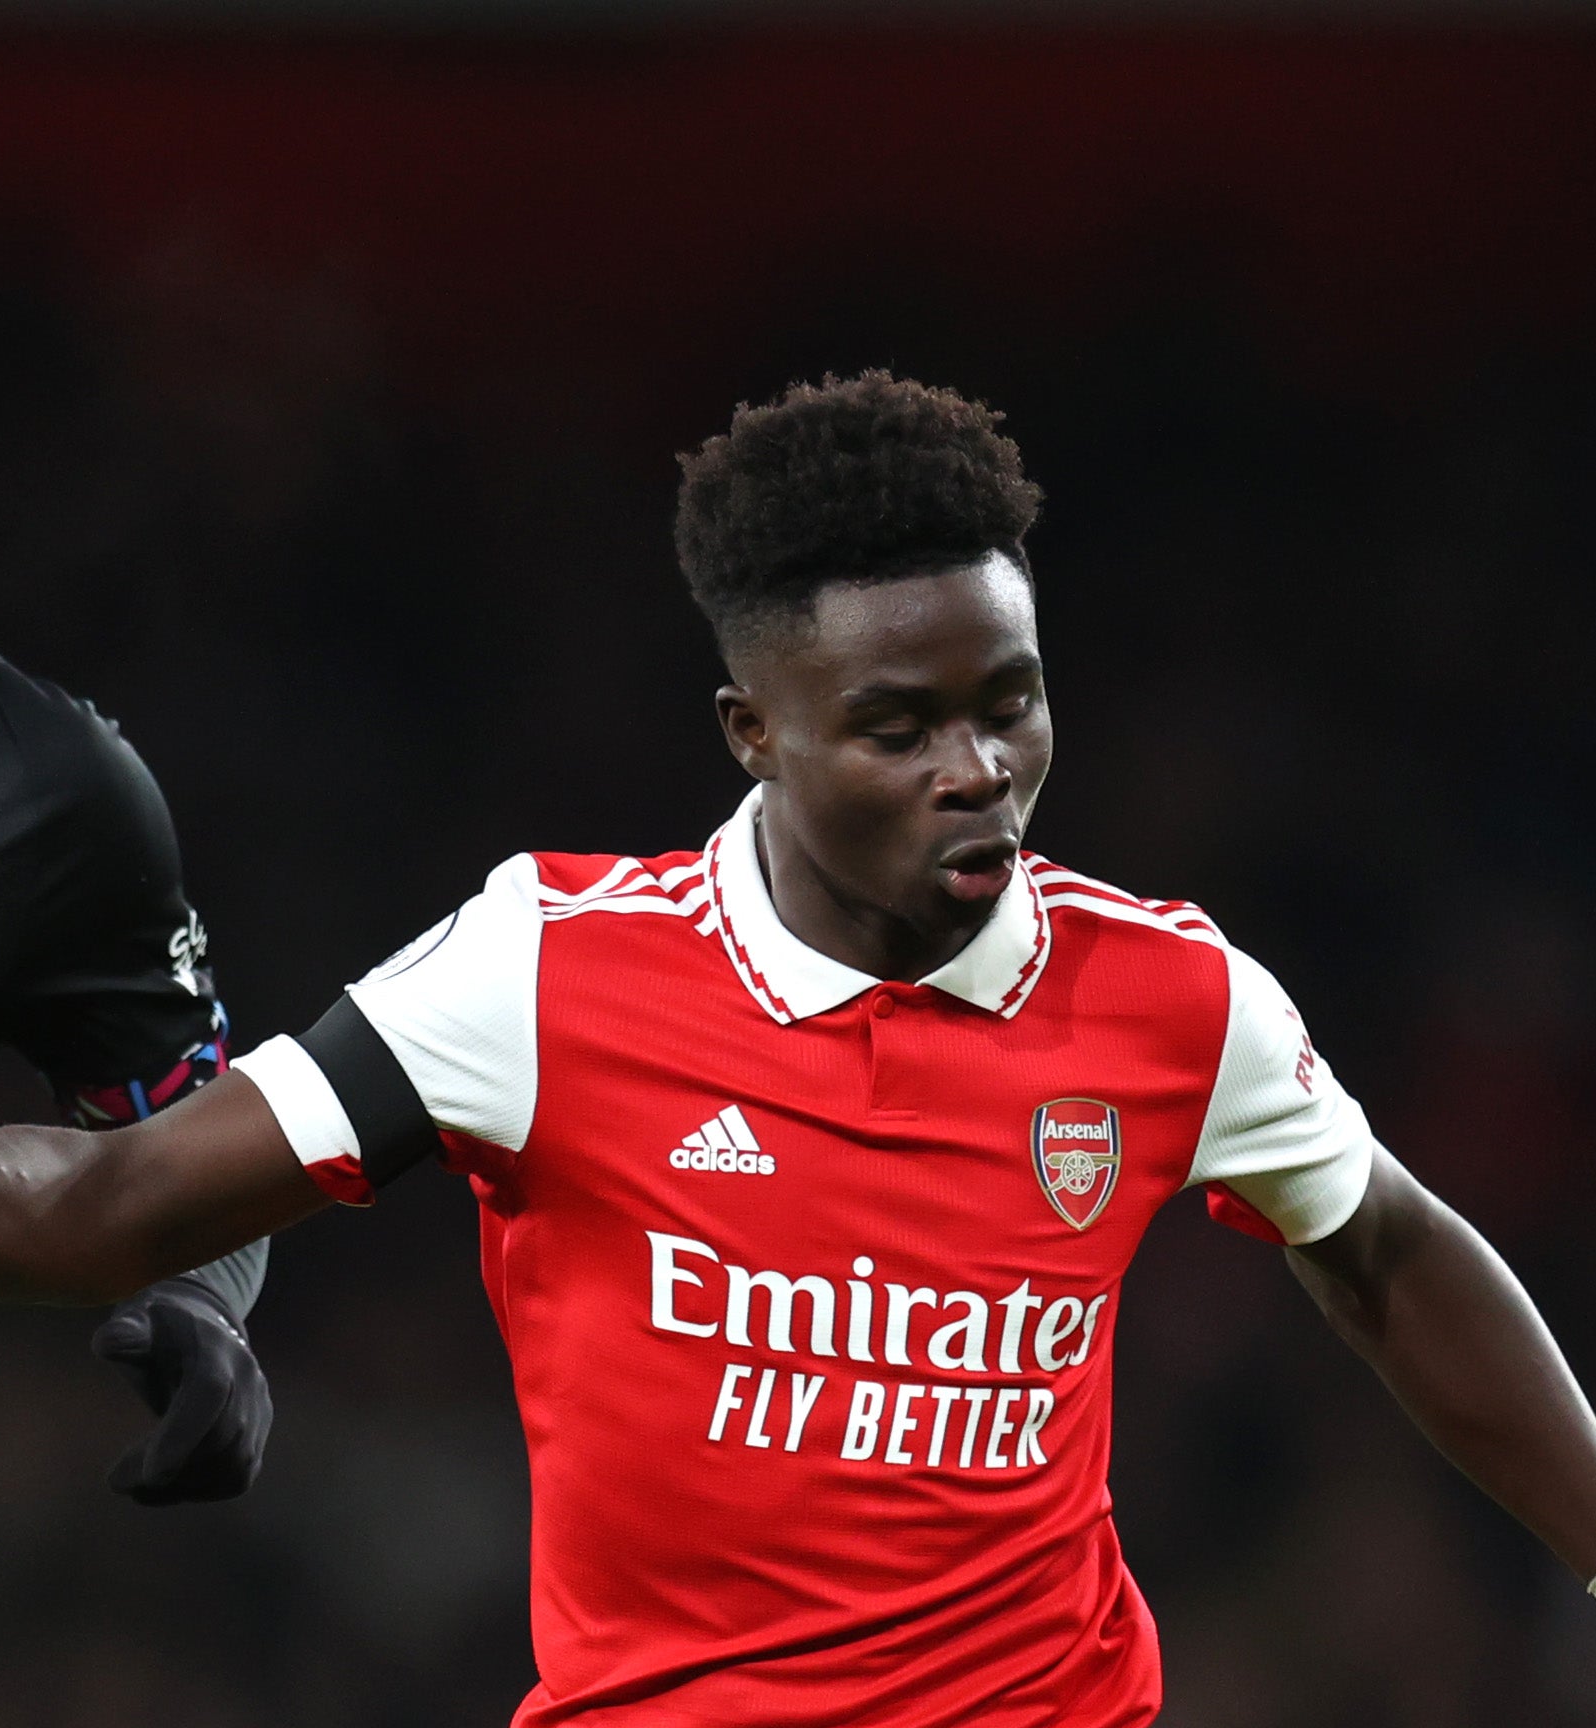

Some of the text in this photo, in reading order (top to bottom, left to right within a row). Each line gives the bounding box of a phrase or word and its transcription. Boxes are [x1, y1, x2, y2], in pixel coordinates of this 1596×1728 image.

[669, 1145, 776, 1176] adidas
[1043, 1119, 1109, 1140] Arsenal
[645, 1229, 1108, 1374] Emirates
[707, 1363, 1056, 1469] FLY BETTER
